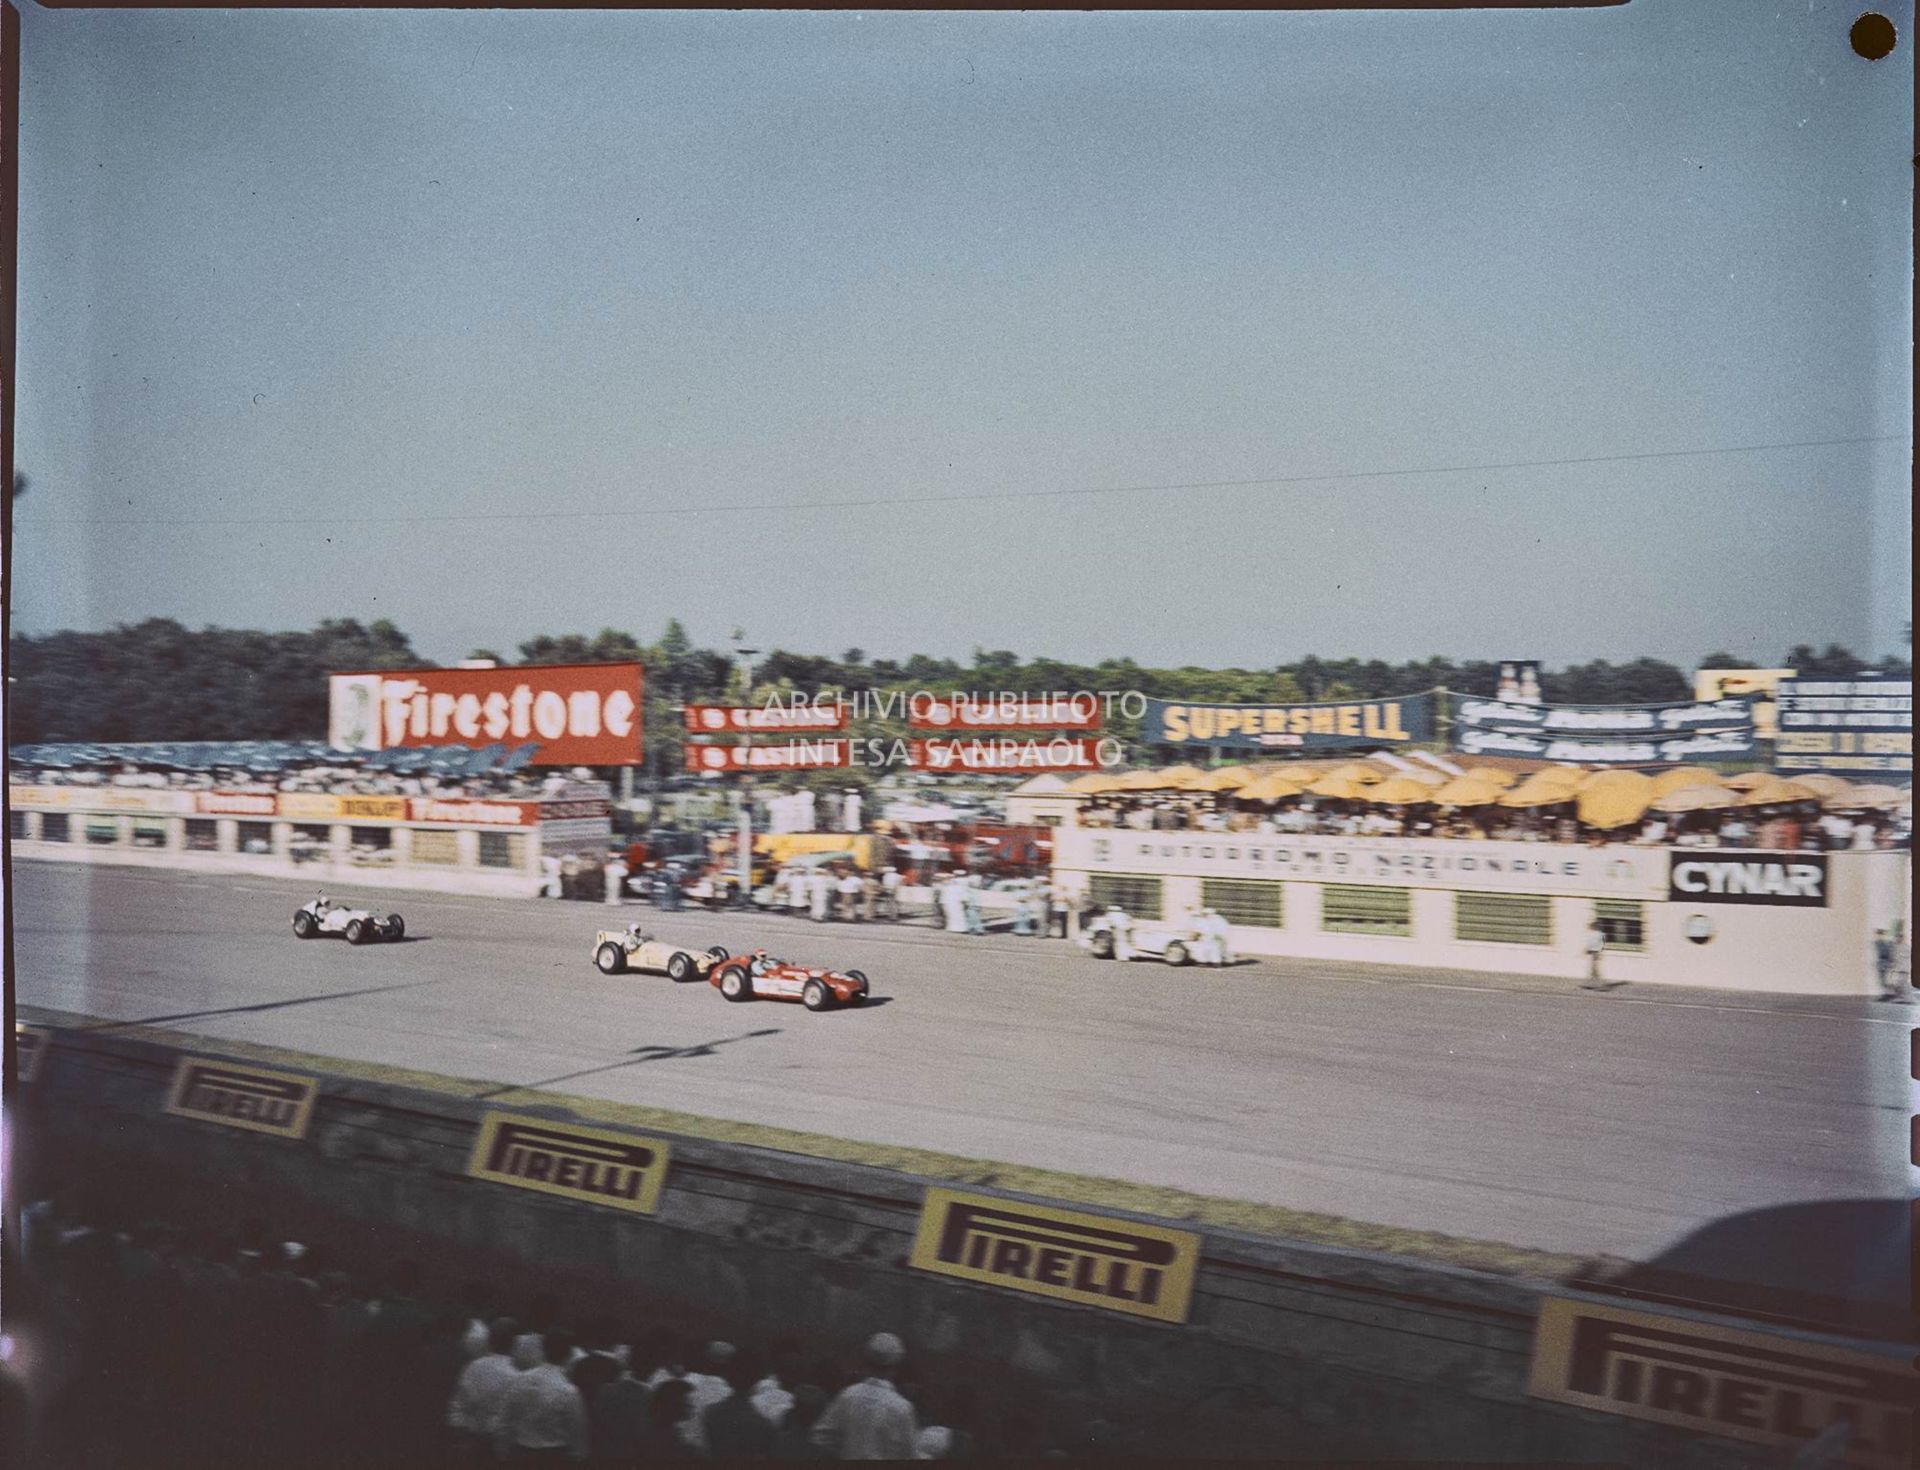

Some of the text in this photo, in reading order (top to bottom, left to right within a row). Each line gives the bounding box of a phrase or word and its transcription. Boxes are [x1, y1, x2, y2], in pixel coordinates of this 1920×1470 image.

[382, 679, 635, 747] Firestone
[1162, 703, 1412, 742] SUPERSHELL
[1136, 844, 1581, 876] AUTODROMO NAZIONALE
[1672, 861, 1824, 897] CYNAR
[485, 1121, 655, 1200] PIRELLI
[937, 1201, 1178, 1306] PIRELLI
